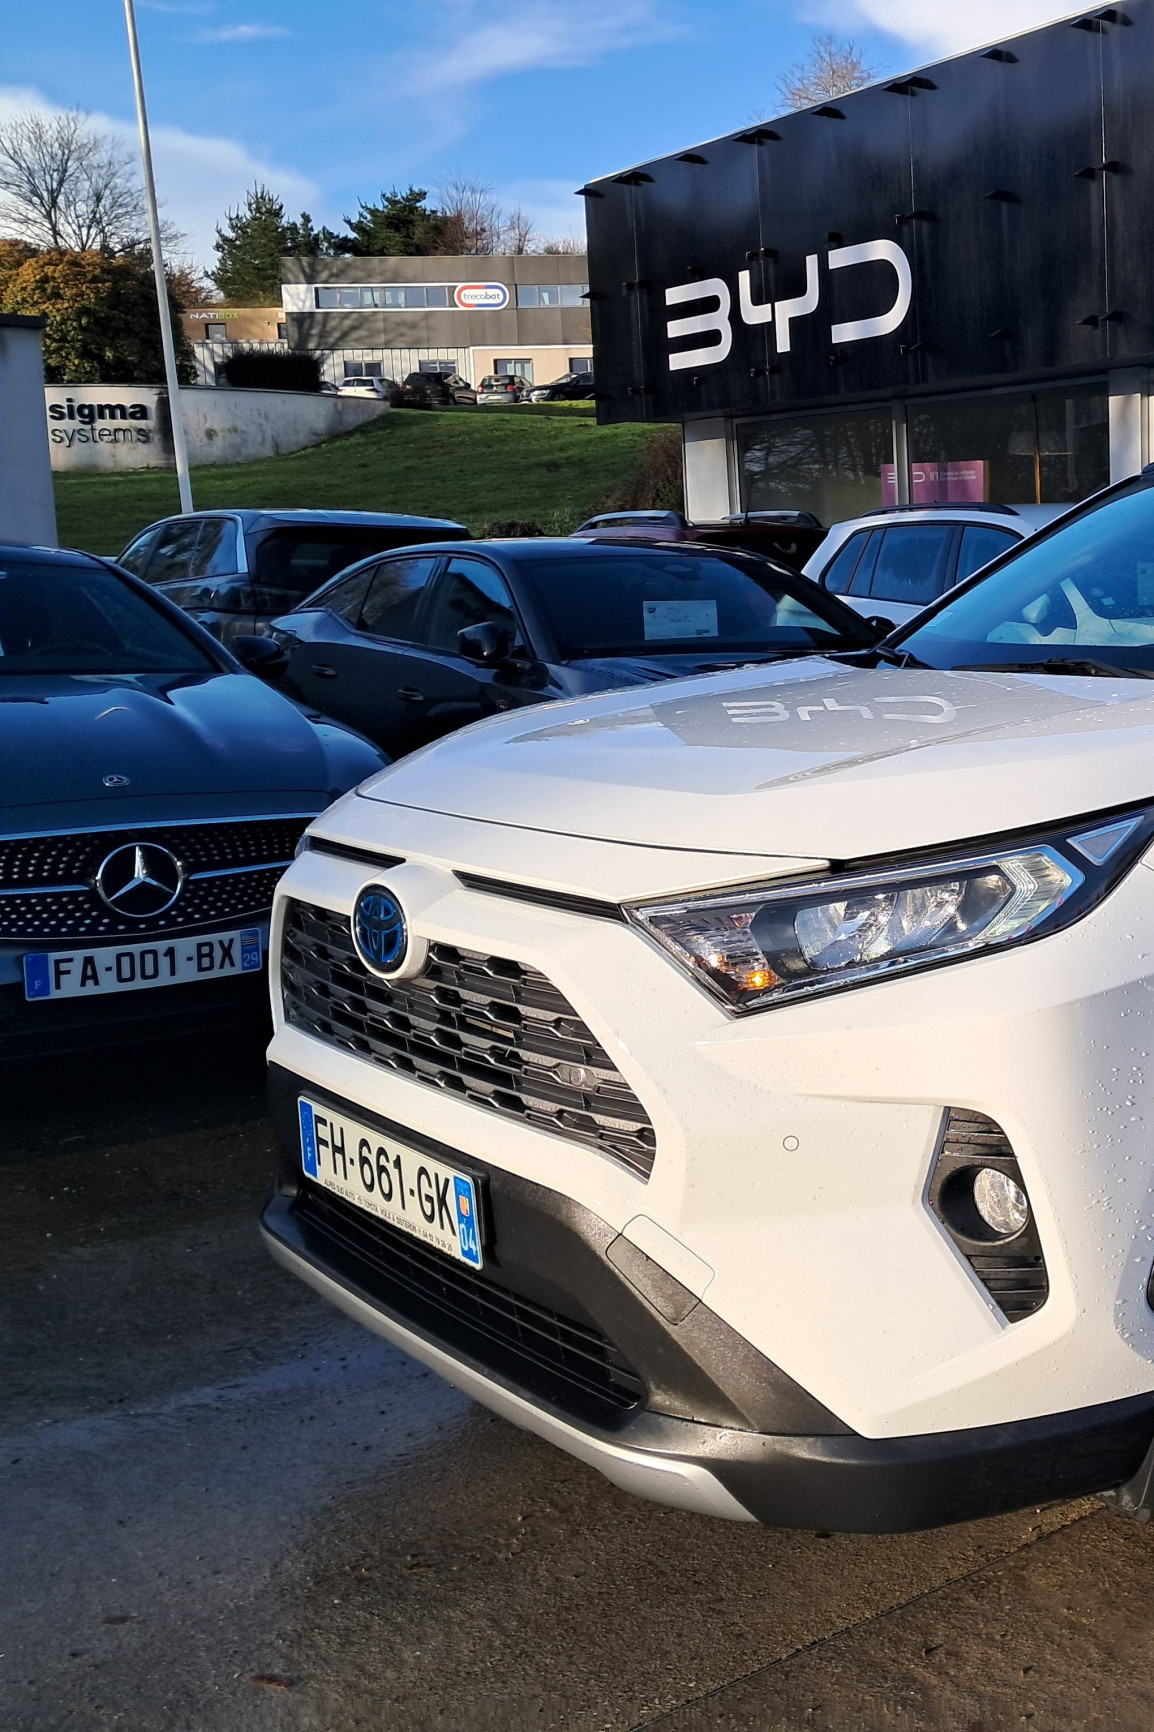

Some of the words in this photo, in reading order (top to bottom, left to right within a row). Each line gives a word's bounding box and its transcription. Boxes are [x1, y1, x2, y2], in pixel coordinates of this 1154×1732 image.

[463, 291, 501, 300] trecobat
[664, 238, 913, 372] BYD
[189, 312, 239, 320] NATIBOX
[48, 397, 149, 425] sigma
[50, 424, 150, 448] systems
[34, 979, 42, 990] F
[53, 937, 236, 991] FA-001-BX
[243, 951, 259, 968] 29
[306, 1146, 312, 1162] F
[313, 1113, 457, 1238] FH-661-GK
[459, 1222, 477, 1256] 04
[363, 1199, 378, 1213] TOYOTA
